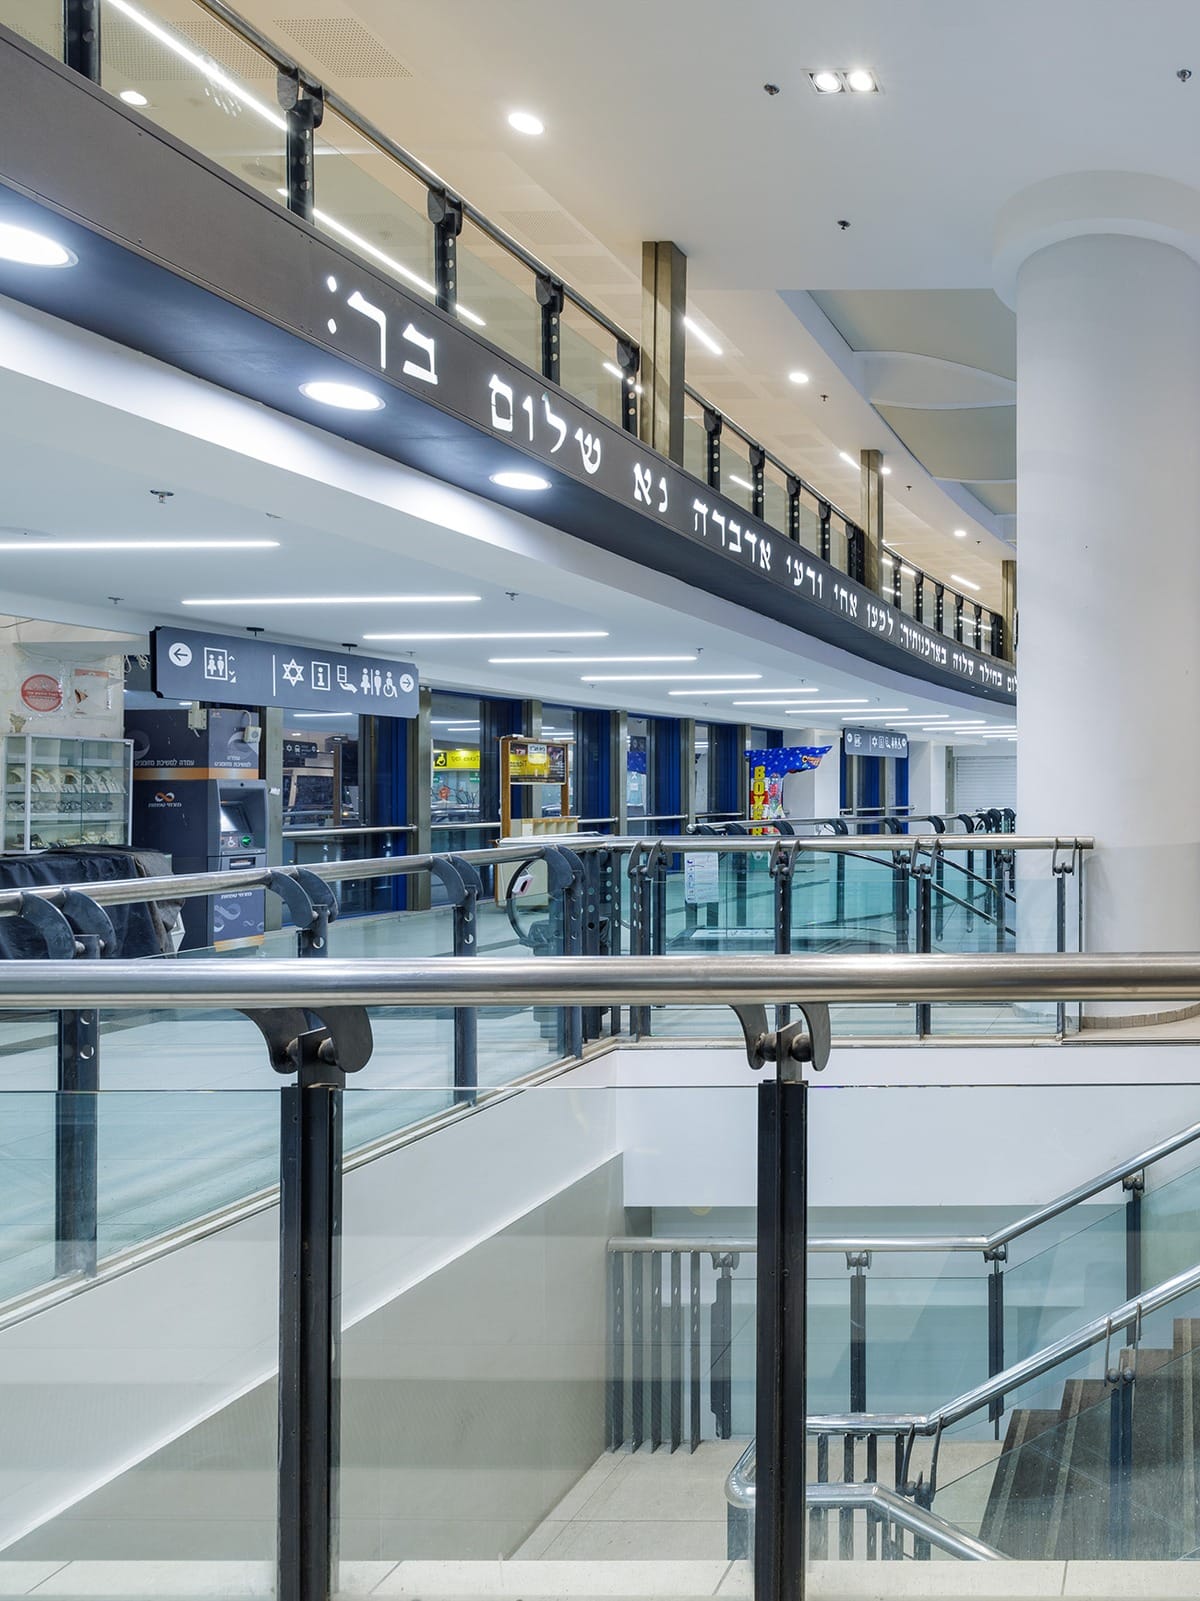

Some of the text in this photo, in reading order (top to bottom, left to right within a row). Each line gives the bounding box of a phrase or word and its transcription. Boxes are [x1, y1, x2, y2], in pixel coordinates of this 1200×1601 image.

[489, 374, 602, 475] שלום
[633, 463, 668, 513] נא
[692, 498, 772, 572] אדברה
[786, 555, 823, 599] ורעי
[833, 583, 857, 619] אחי
[866, 603, 894, 636] למען
[953, 652, 975, 676] שלוה
[979, 662, 1003, 687] בחילך
